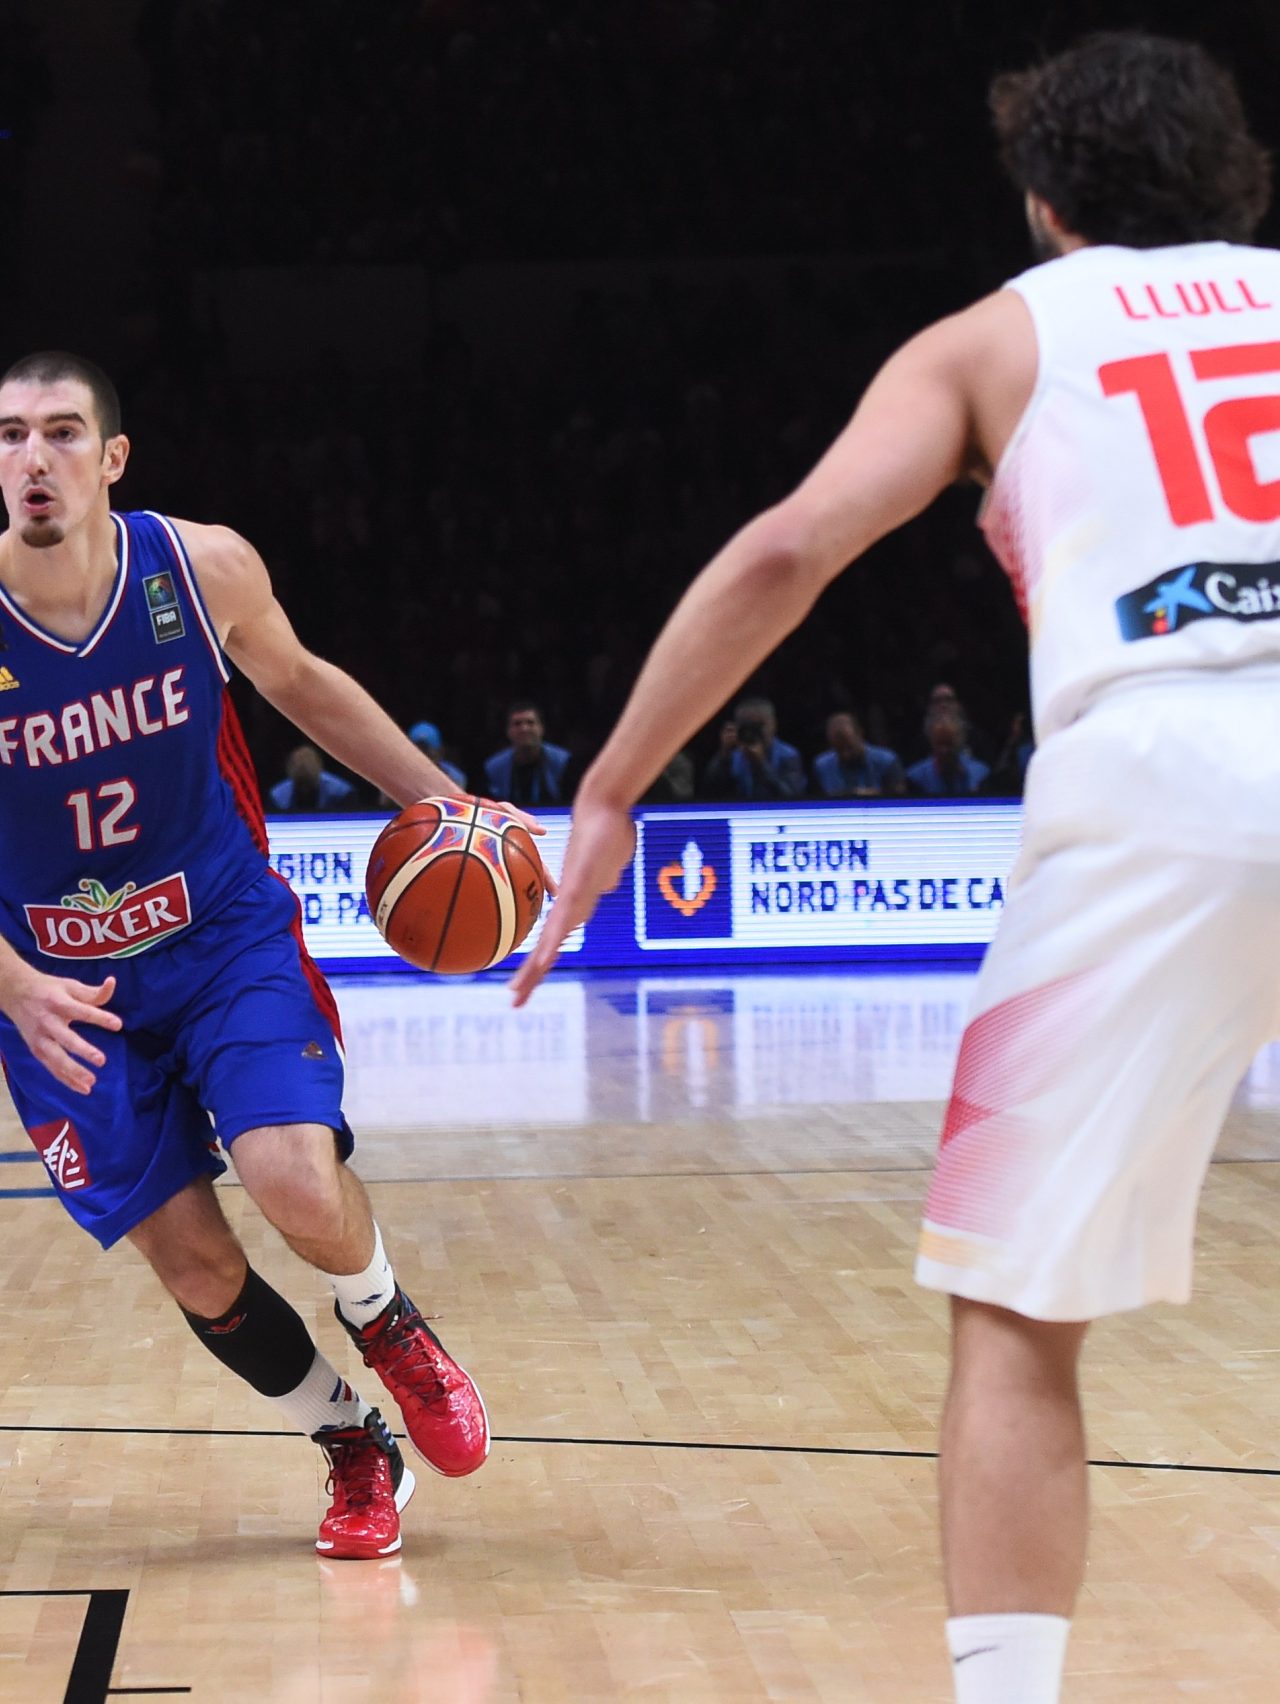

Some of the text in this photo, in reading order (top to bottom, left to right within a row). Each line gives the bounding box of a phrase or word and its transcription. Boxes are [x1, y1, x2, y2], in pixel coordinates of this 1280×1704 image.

[1114, 278, 1272, 320] LLULL
[67, 778, 140, 851] 12
[751, 825, 868, 872] RÉGION
[45, 896, 184, 949] JOKER
